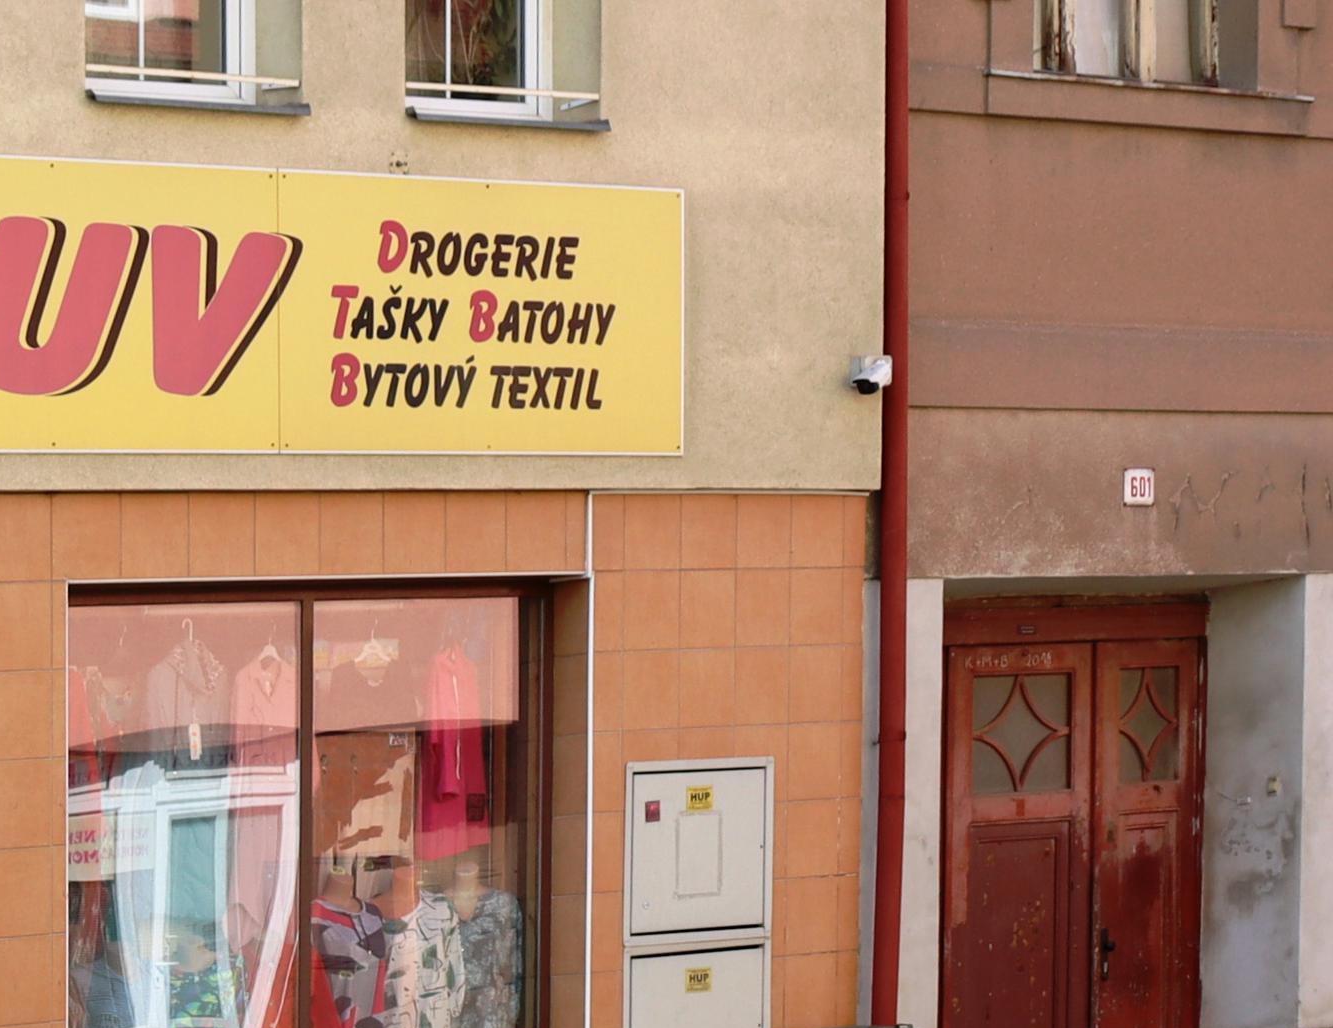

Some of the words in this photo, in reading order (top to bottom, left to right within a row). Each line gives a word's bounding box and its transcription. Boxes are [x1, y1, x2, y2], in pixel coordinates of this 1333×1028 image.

[377, 219, 579, 281] DROGERIE
[331, 284, 449, 343] TAŠKY
[468, 290, 616, 346] BATOHY
[330, 352, 477, 408] BYTOVÝ
[489, 365, 602, 410] TEXTIL
[1131, 476, 1151, 497] 601
[690, 792, 710, 801] HUP
[689, 973, 710, 984] HUP
